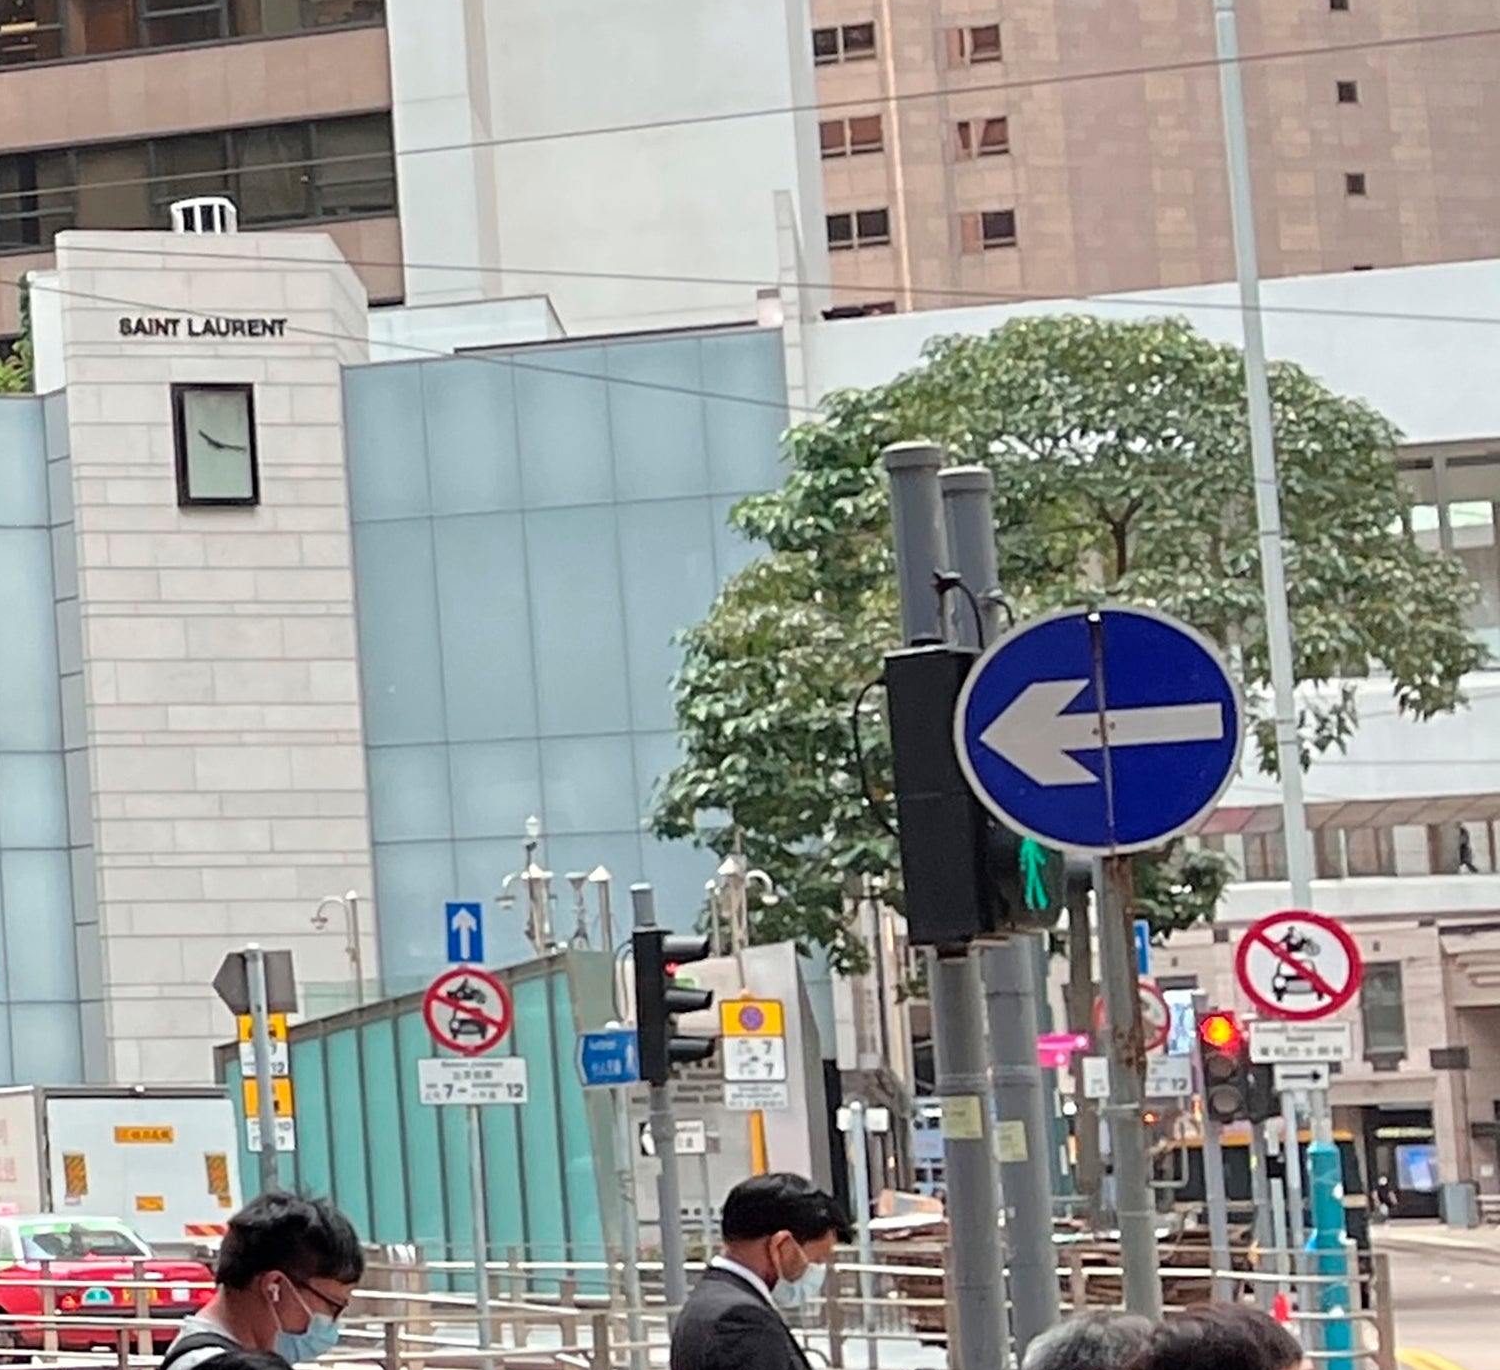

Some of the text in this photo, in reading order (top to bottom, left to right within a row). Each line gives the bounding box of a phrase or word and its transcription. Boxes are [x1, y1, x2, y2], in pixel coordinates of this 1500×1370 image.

[119, 316, 288, 337] SAINT LAURENT
[763, 1041, 773, 1054] 7
[764, 1063, 774, 1076] 7
[443, 1083, 454, 1099] 7
[506, 1083, 524, 1098] 12
